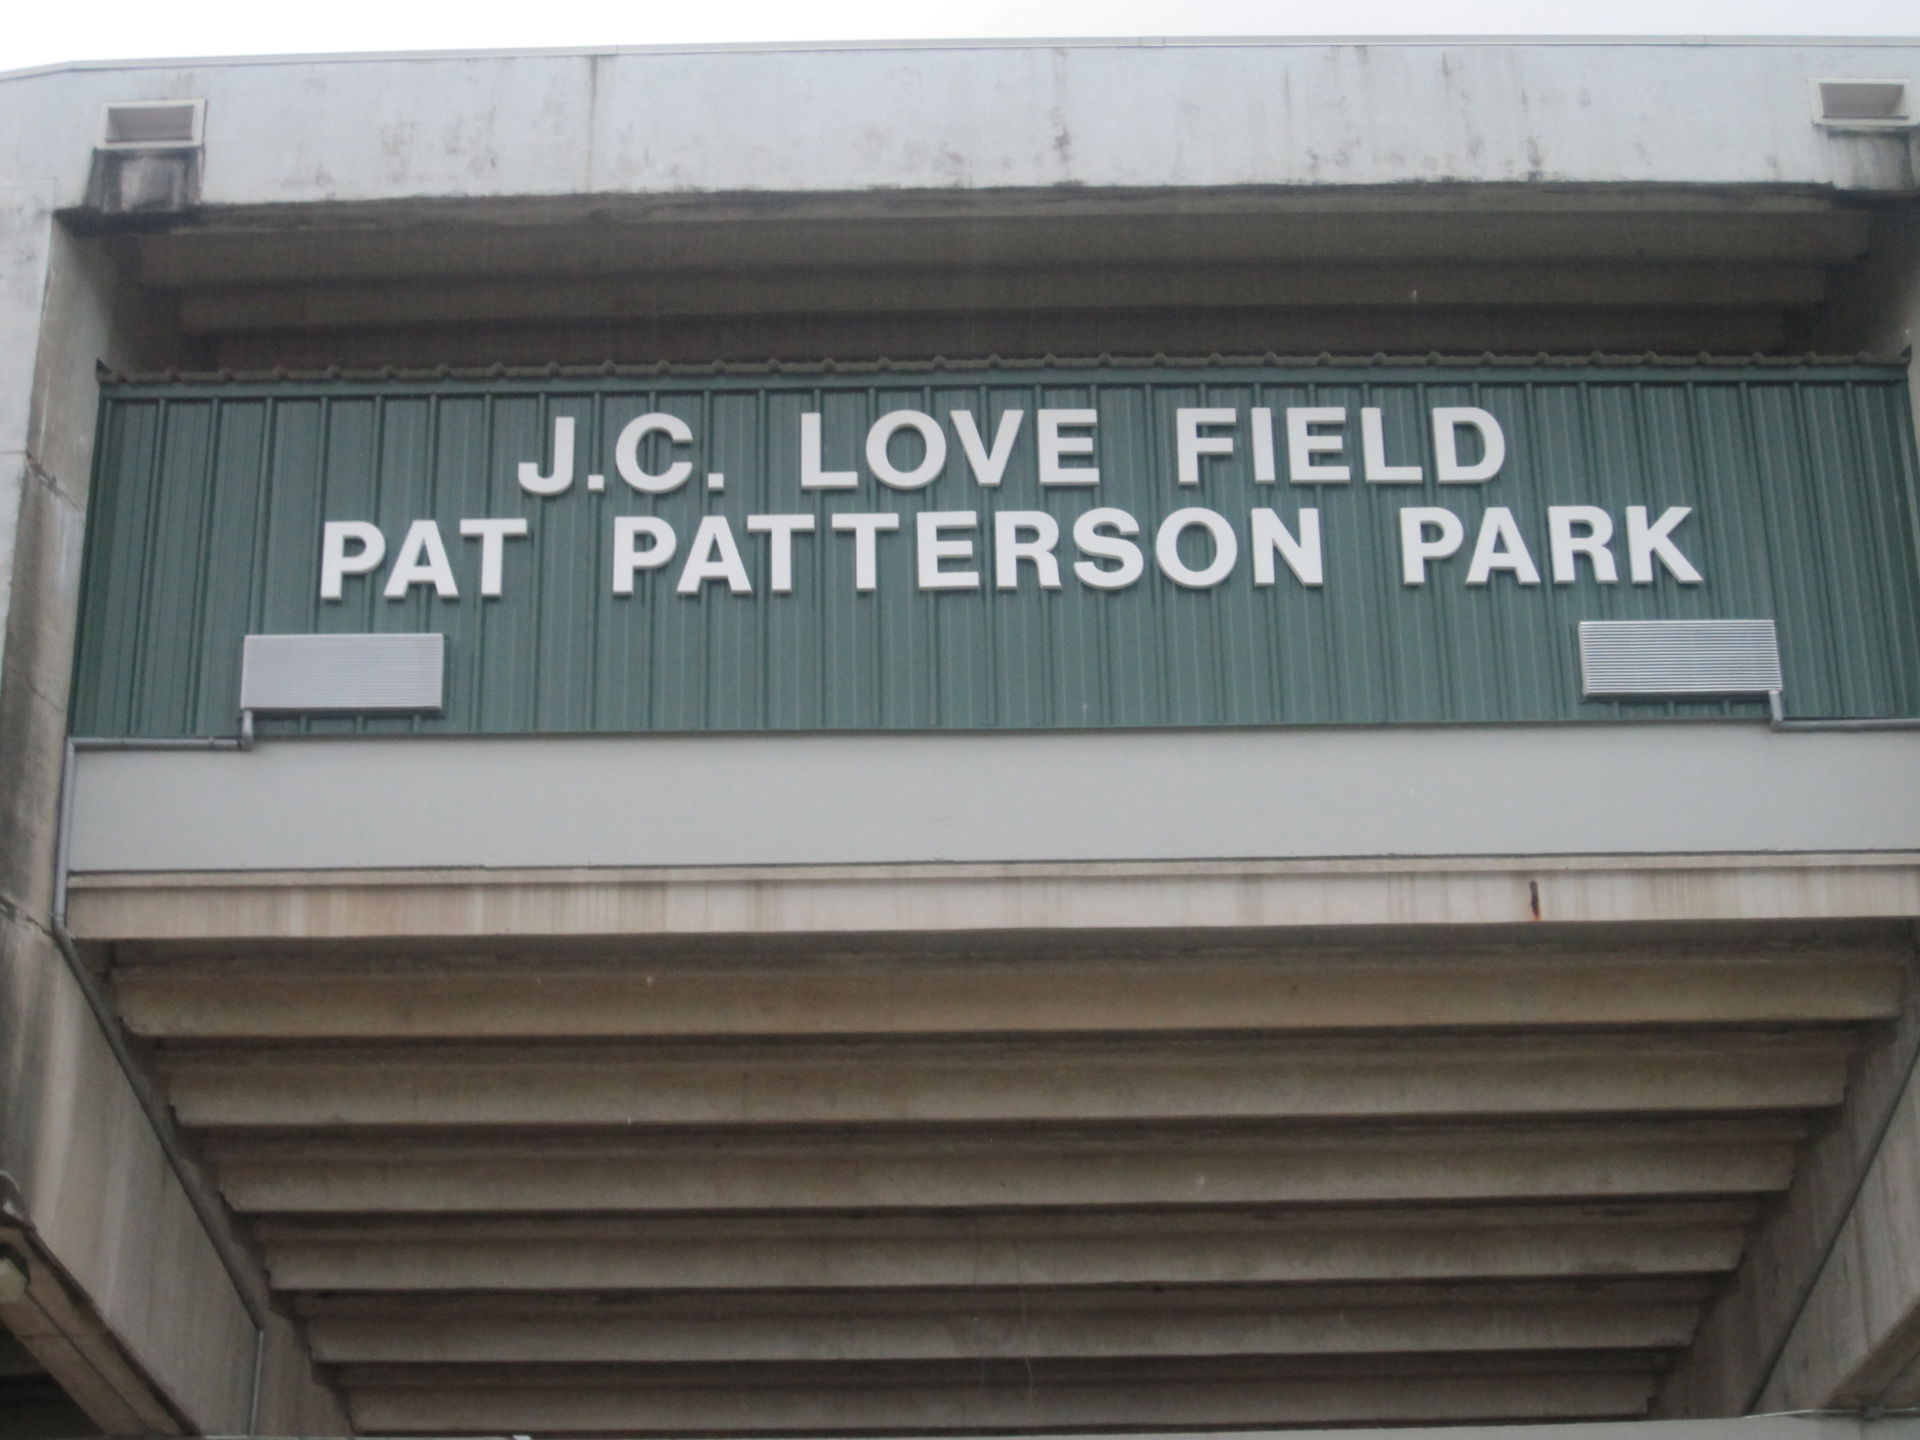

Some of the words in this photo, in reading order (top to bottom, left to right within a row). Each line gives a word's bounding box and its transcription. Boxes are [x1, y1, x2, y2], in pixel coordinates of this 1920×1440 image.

[515, 409, 727, 495] J.C.
[798, 404, 1102, 489] LOVE
[1174, 402, 1507, 487] FIELD
[318, 516, 530, 601] PAT
[610, 505, 1325, 597] PATTERSON
[1397, 503, 1704, 587] PARK
